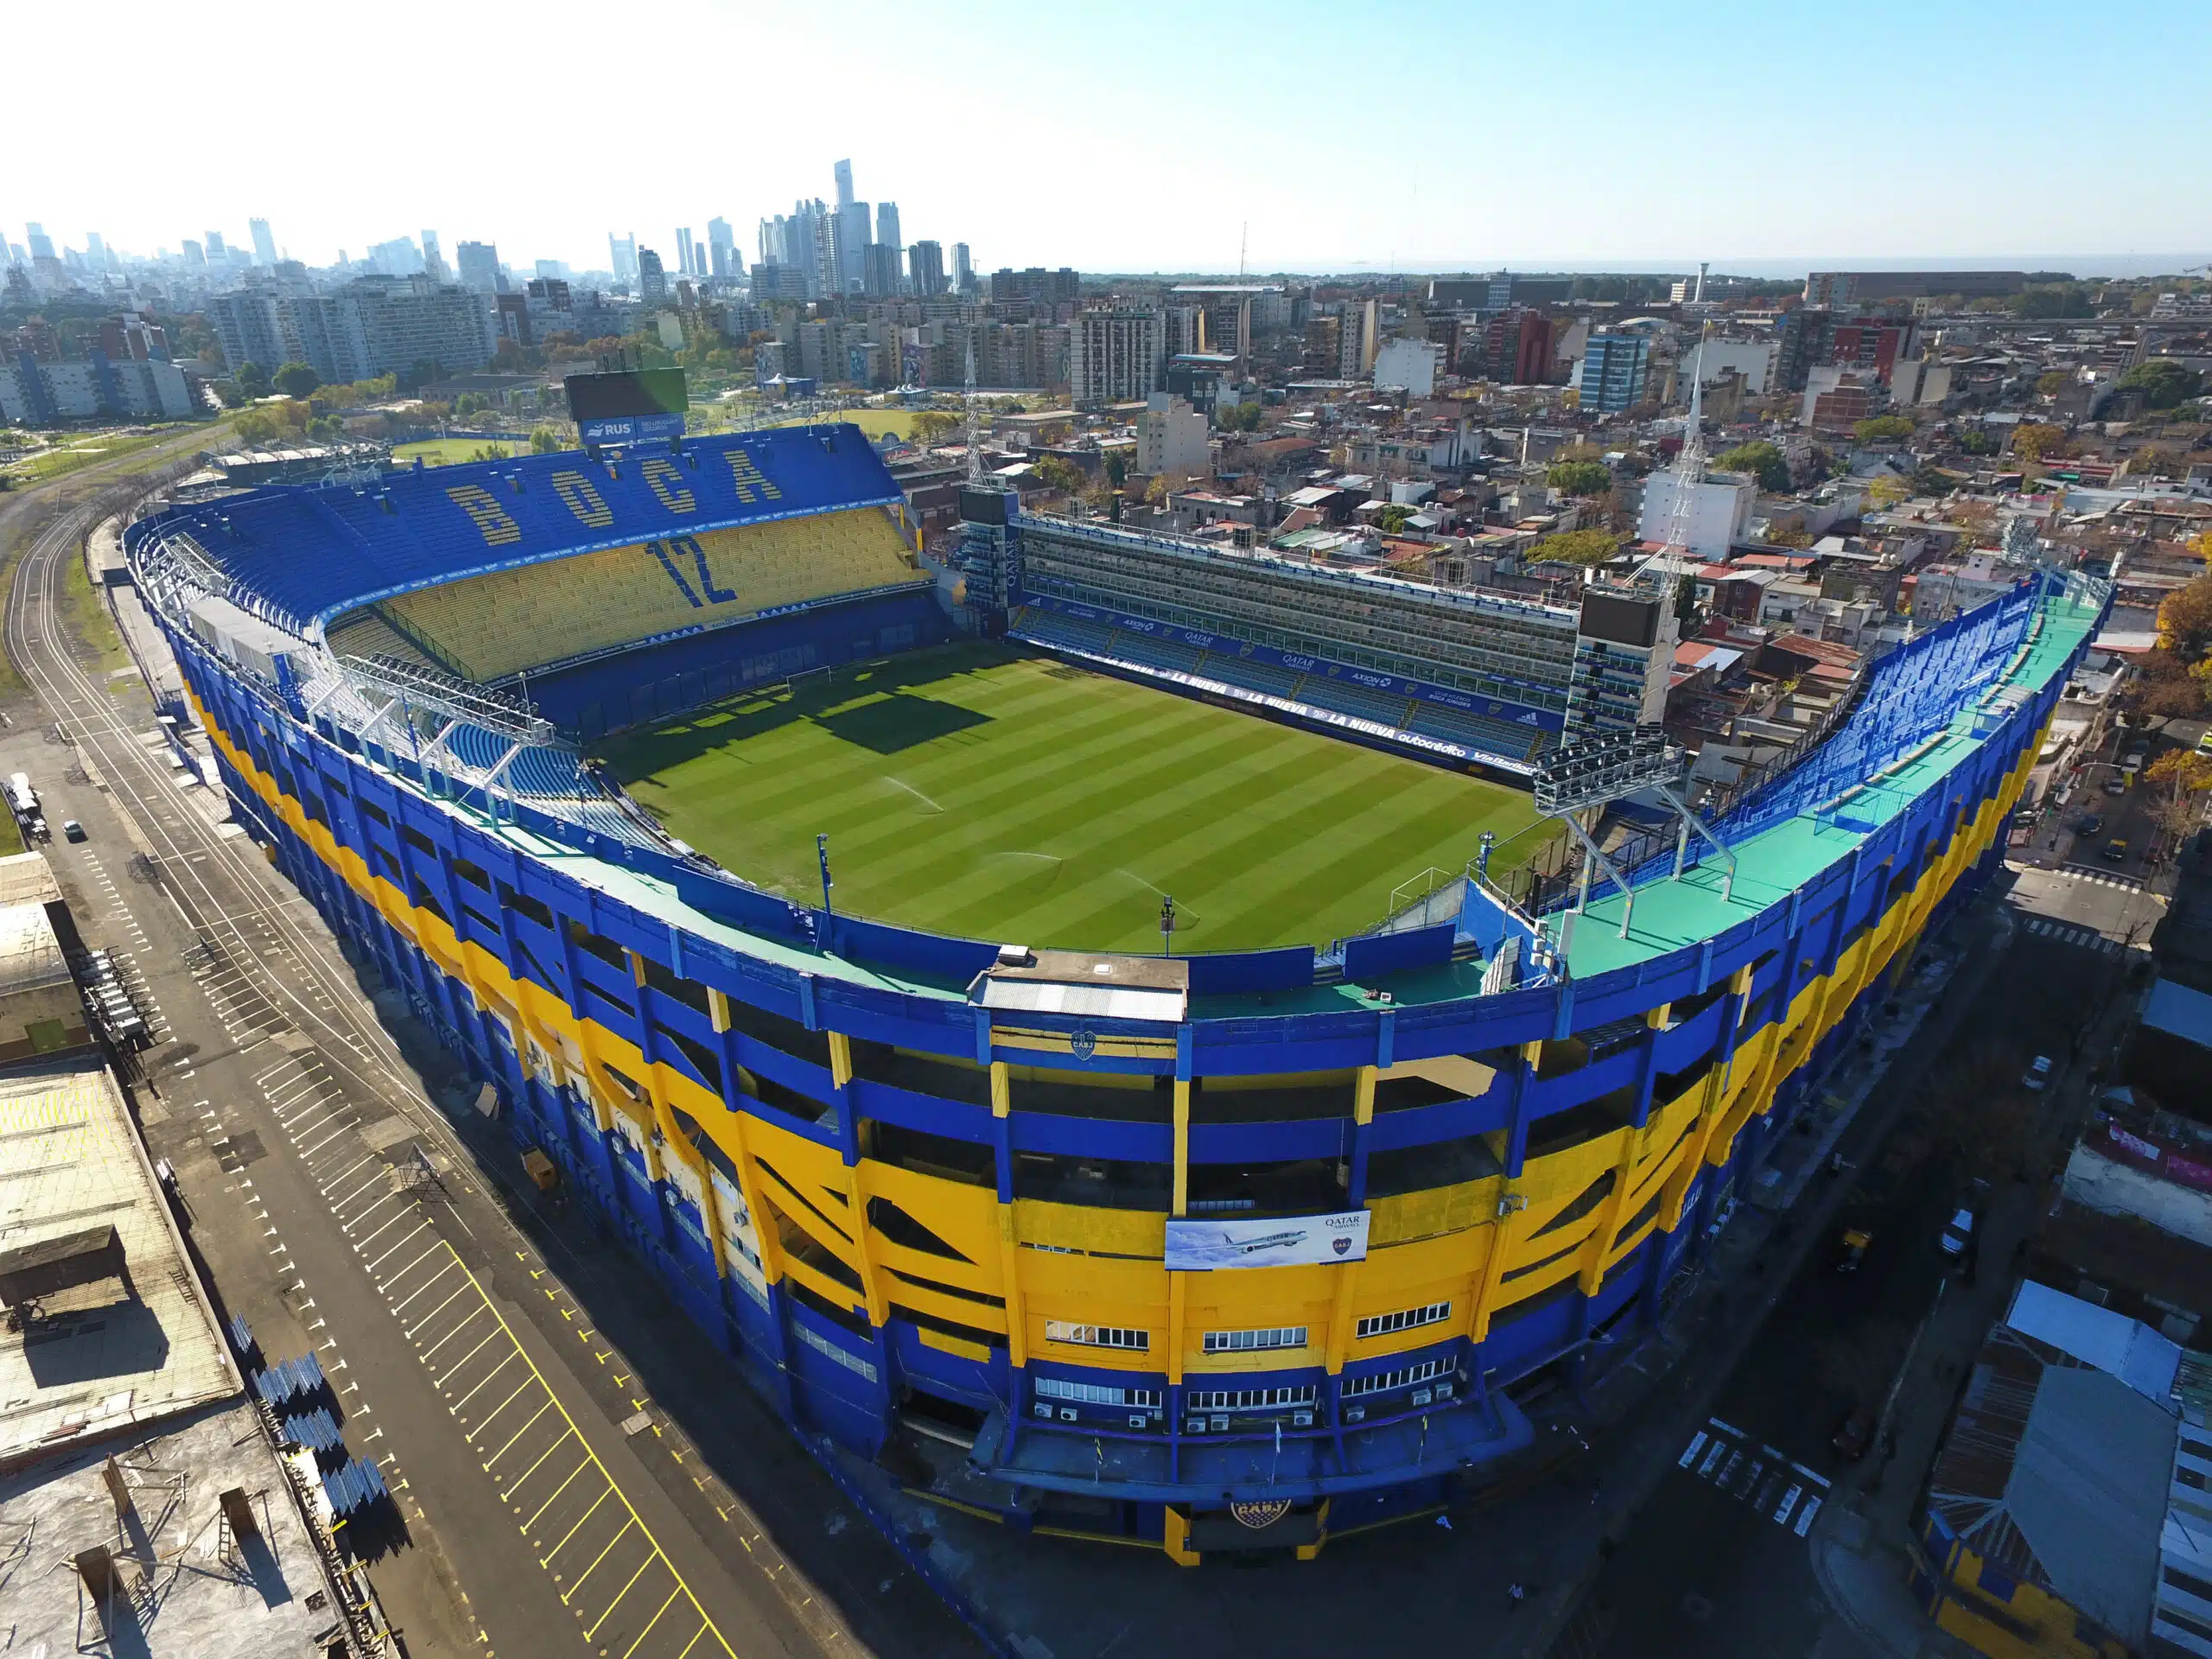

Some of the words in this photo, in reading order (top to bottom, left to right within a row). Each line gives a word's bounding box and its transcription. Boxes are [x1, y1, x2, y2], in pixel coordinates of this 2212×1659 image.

[605, 423, 632, 435] RUS
[446, 449, 782, 547] BOCA
[645, 535, 738, 608] 12
[1006, 538, 1016, 588] QATAR
[1185, 632, 1214, 645] QATAR
[1282, 654, 1315, 667] QATAR
[1286, 663, 1312, 672] AIRWAYS
[1171, 672, 1187, 685] LA
[1187, 677, 1227, 695] NUEVA
[1351, 672, 1381, 684] AXION
[1246, 692, 1264, 704] LA
[1265, 697, 1308, 716] NUEVA
[1327, 714, 1347, 727] LA
[1347, 719, 1396, 740] NUEVA
[1397, 734, 1466, 758] autocrédito
[1325, 1215, 1360, 1226] QATAR
[1237, 1503, 1283, 1516] CABJ
